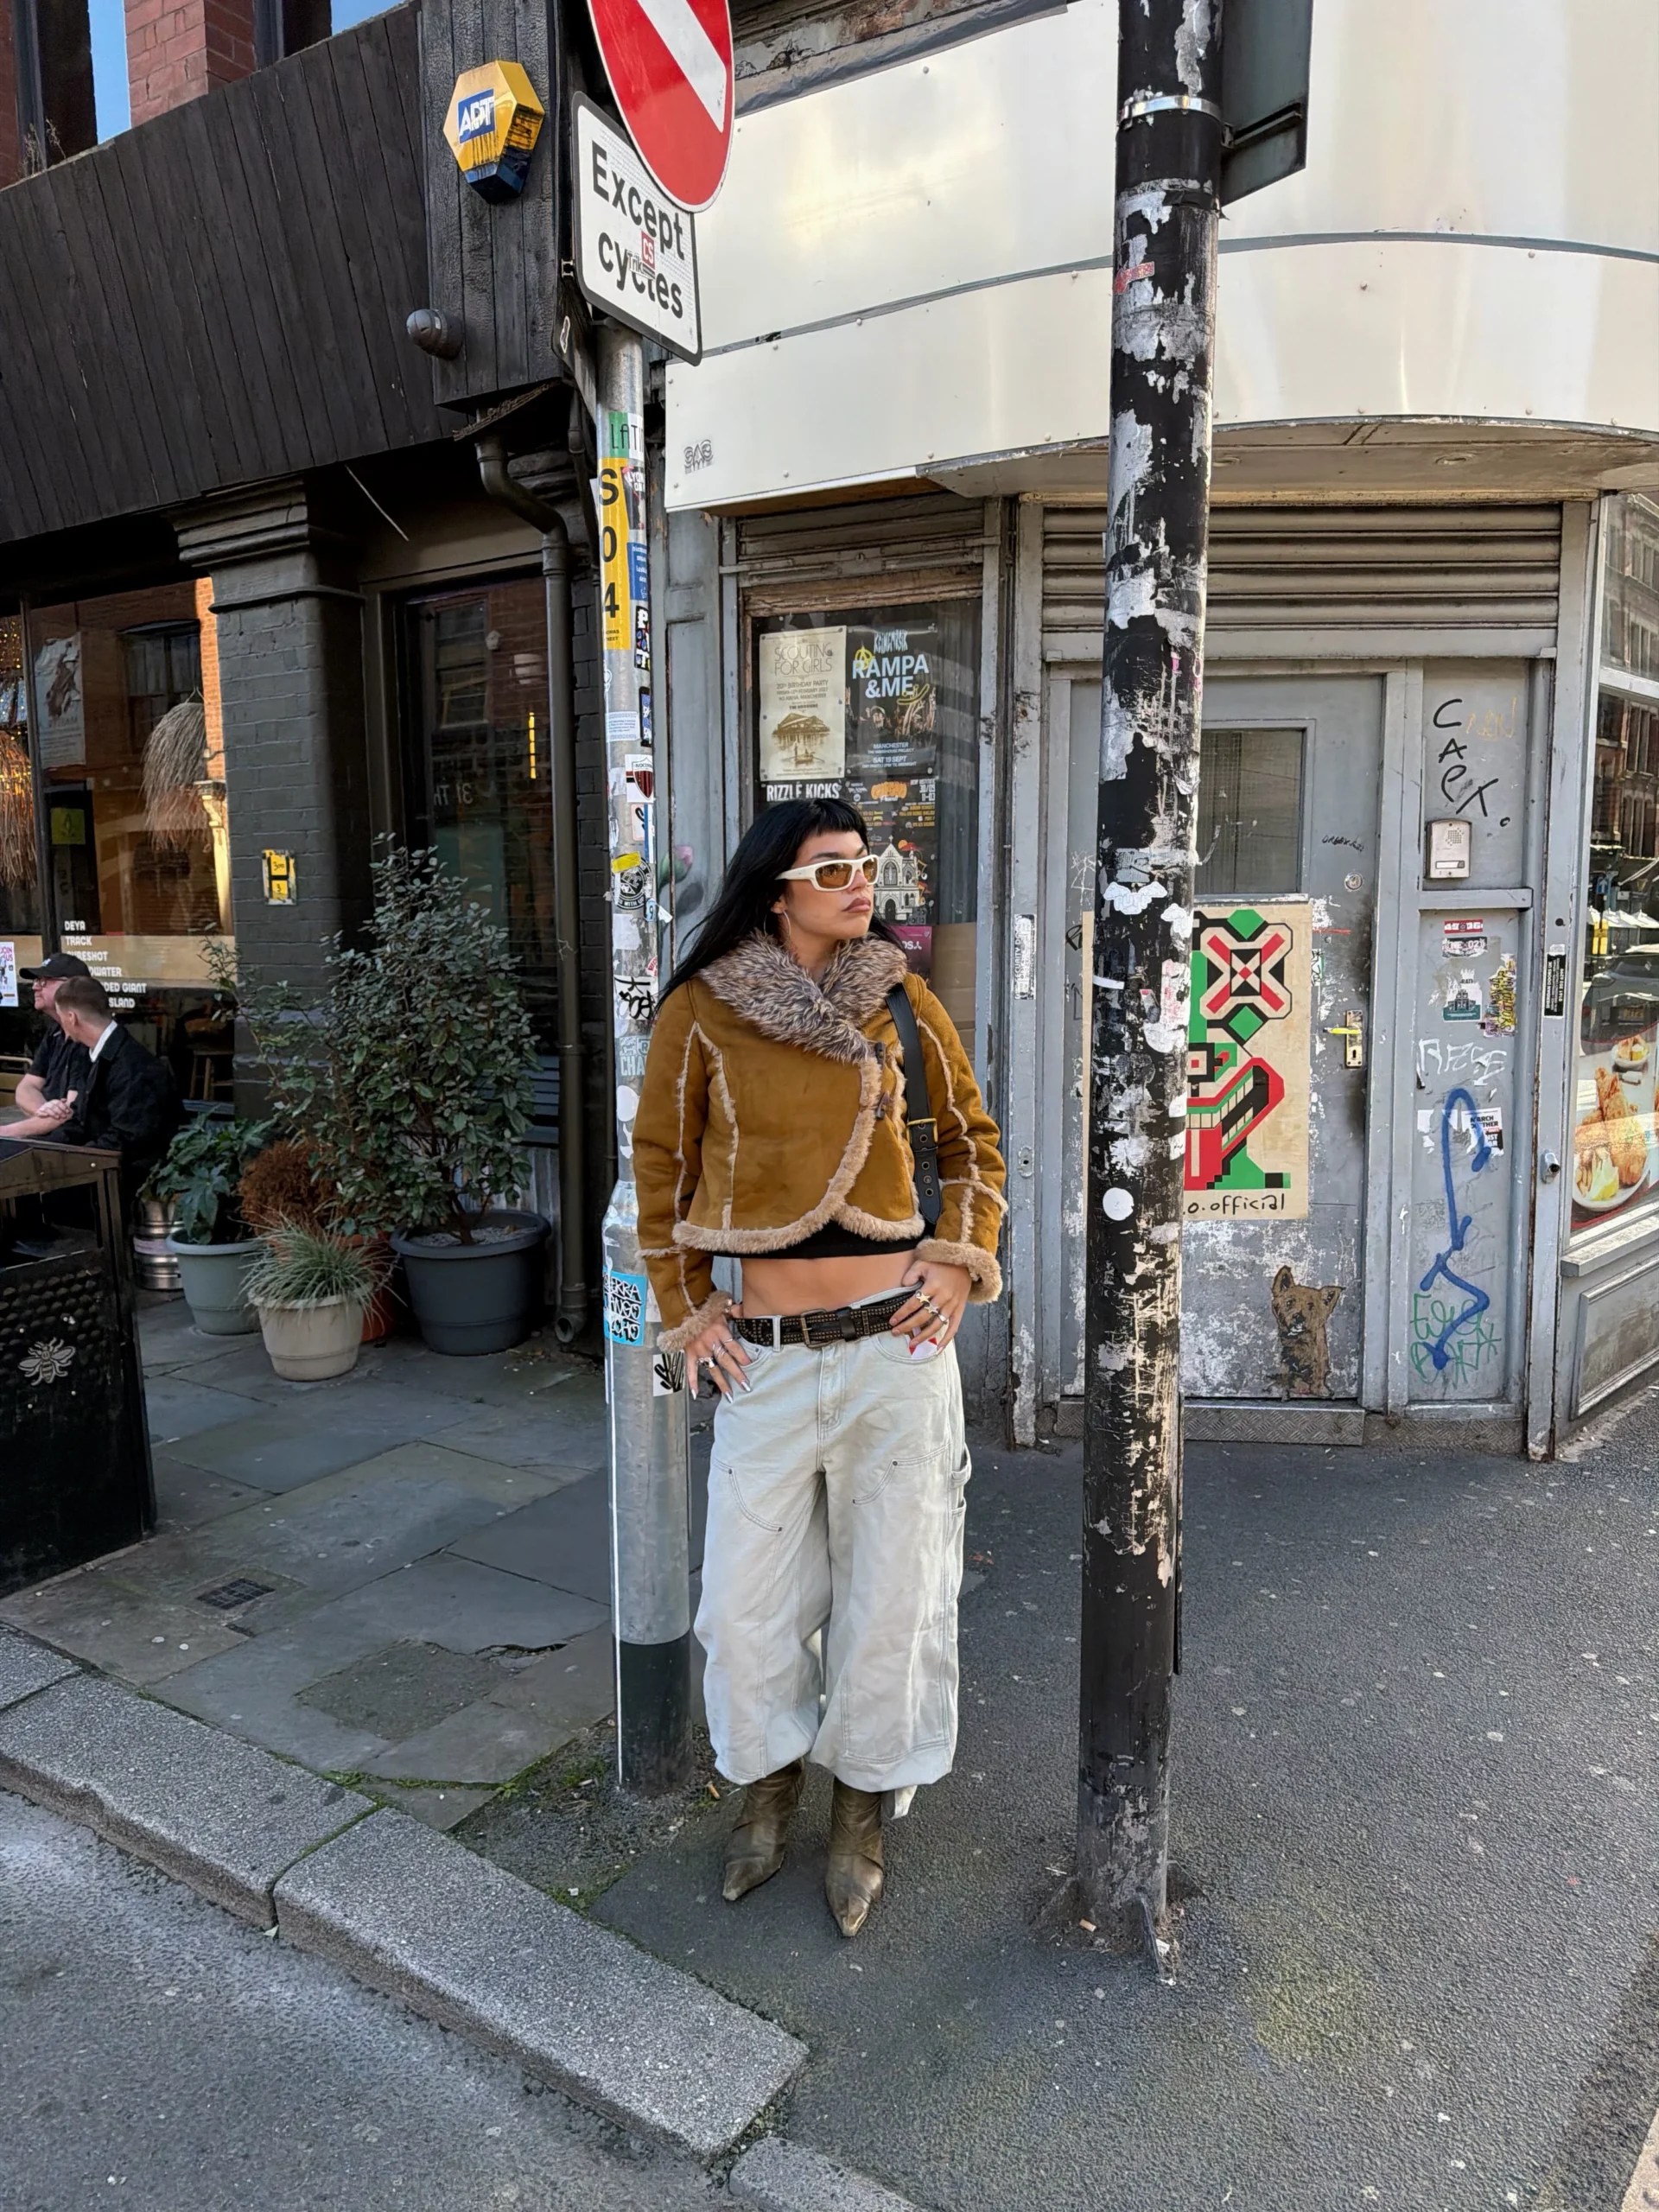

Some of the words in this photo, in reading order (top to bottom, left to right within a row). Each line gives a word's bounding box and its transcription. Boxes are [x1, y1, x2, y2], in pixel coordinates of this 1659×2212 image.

[460, 95, 494, 137] ADT
[591, 140, 685, 261] Except
[774, 642, 833, 662] SCOUTING
[774, 660, 798, 676] FOR
[803, 658, 833, 674] GIRLS
[852, 654, 930, 679] RAMPA
[865, 676, 913, 698] &ME
[766, 784, 802, 802] RIZZLE
[805, 782, 840, 799] KICKS
[65, 920, 86, 931] DEYA
[65, 936, 92, 946] TRACK
[89, 967, 123, 977] DWATER
[123, 982, 147, 994] GIANT
[108, 997, 136, 1008] SLAND
